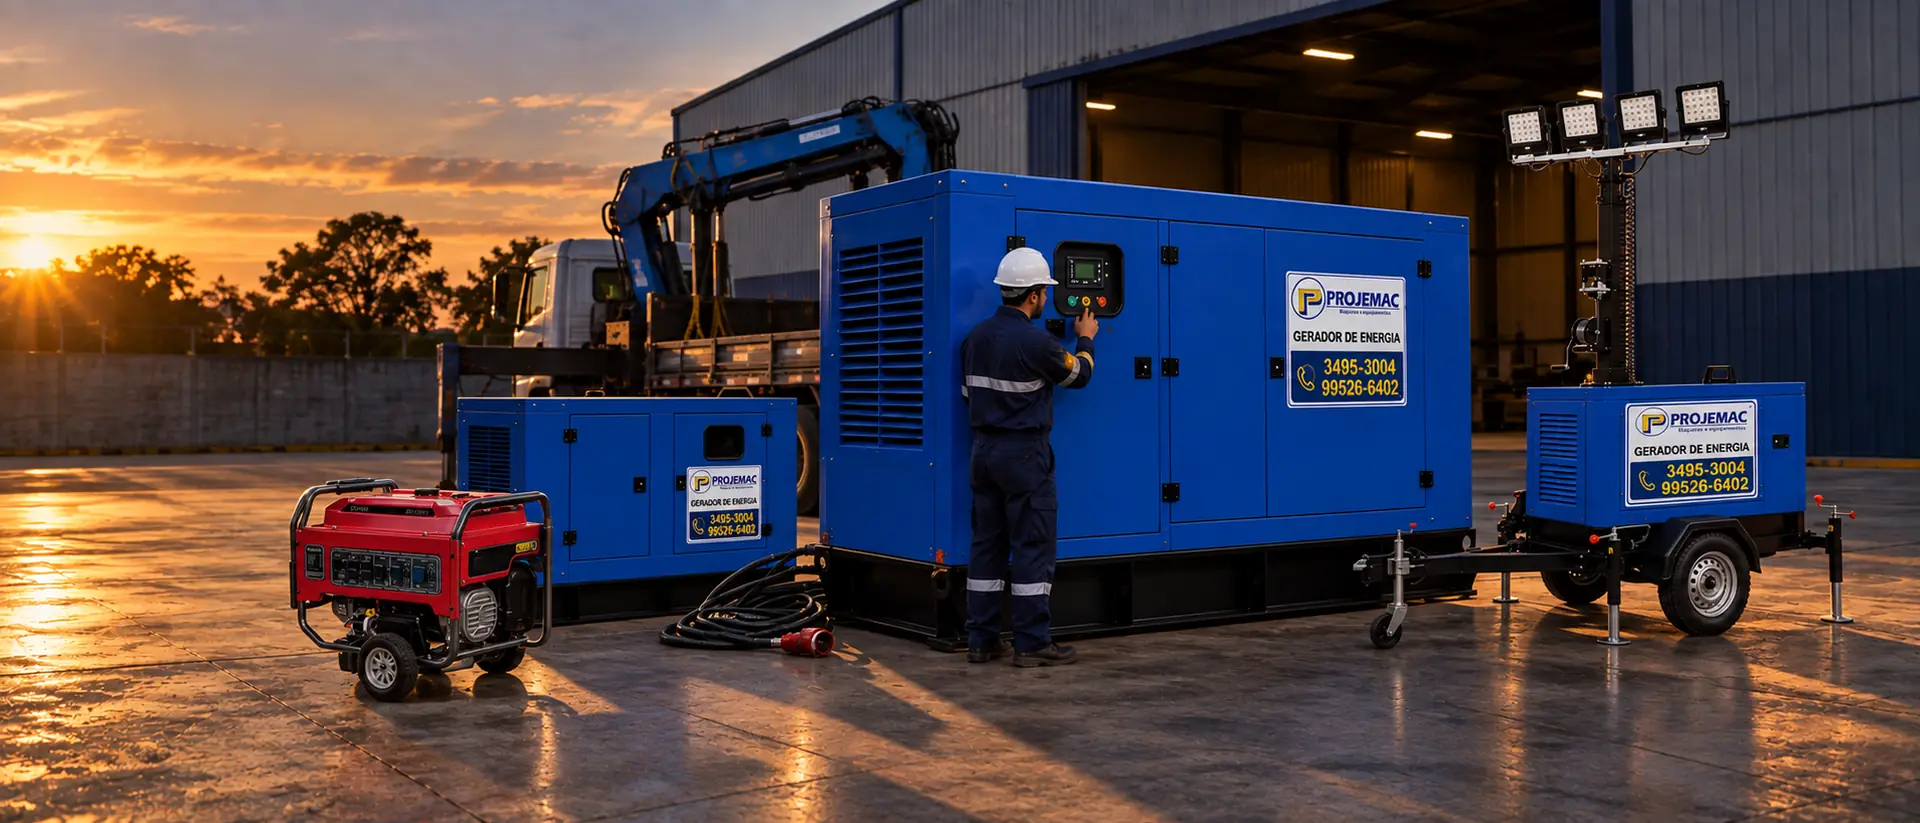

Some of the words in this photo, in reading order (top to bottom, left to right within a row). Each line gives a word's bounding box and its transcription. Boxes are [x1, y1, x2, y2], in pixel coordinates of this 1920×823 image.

[1326, 290, 1400, 308] PROJEMAC
[1293, 330, 1342, 343] GERADOR
[1345, 331, 1358, 343] DE
[1360, 332, 1401, 343] ENERGIA
[1324, 358, 1396, 375] 3495-3004
[1321, 379, 1399, 396] 99526-6402
[1670, 411, 1747, 426] PROJEMAC
[1634, 445, 1687, 457] GERADOR
[1689, 444, 1703, 454] DE
[1706, 442, 1750, 453] ENERGIA
[1666, 460, 1746, 478] 3495-3004
[712, 475, 757, 485] PROJEMAC
[1661, 477, 1749, 495] 99526-6402
[690, 498, 721, 507] GERADOR
[722, 498, 731, 506] DE
